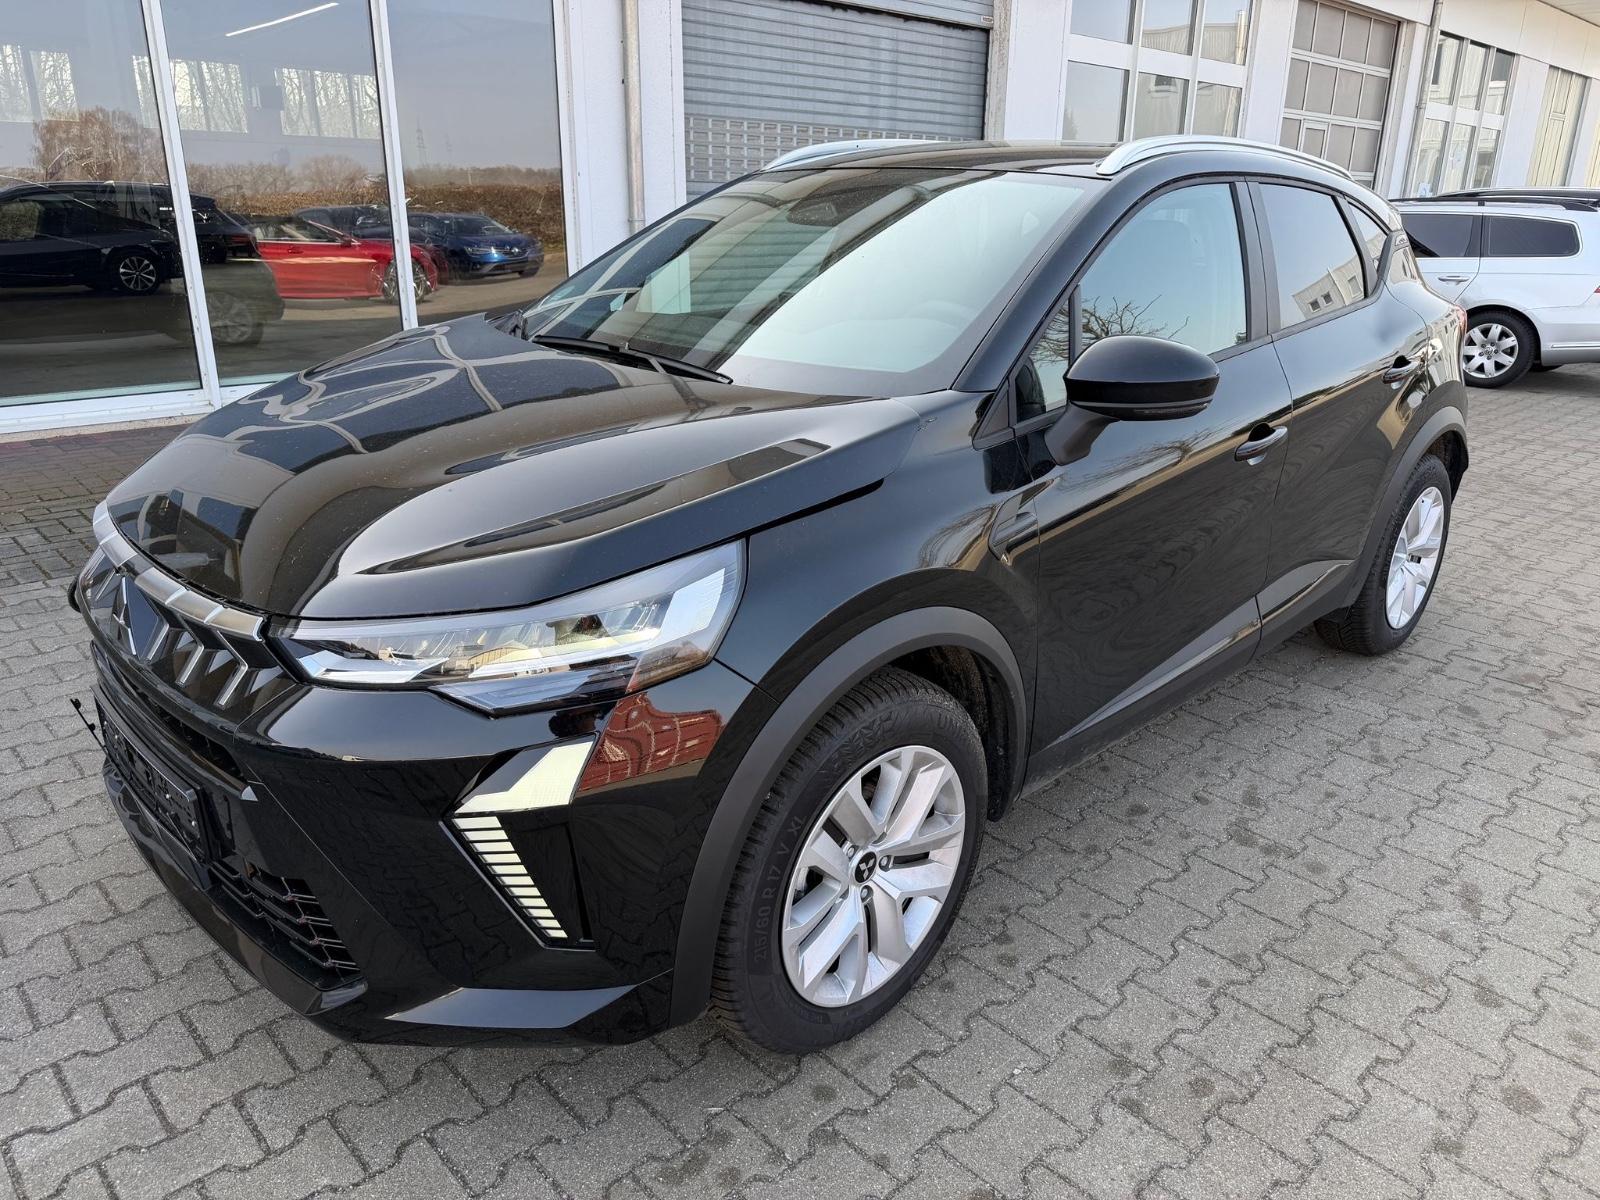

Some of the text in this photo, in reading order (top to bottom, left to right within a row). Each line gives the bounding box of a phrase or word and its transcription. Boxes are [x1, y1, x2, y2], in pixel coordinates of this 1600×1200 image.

[777, 843, 789, 855] V
[767, 865, 781, 881] 17
[762, 887, 776, 900] R
[754, 906, 771, 962] 215/60
